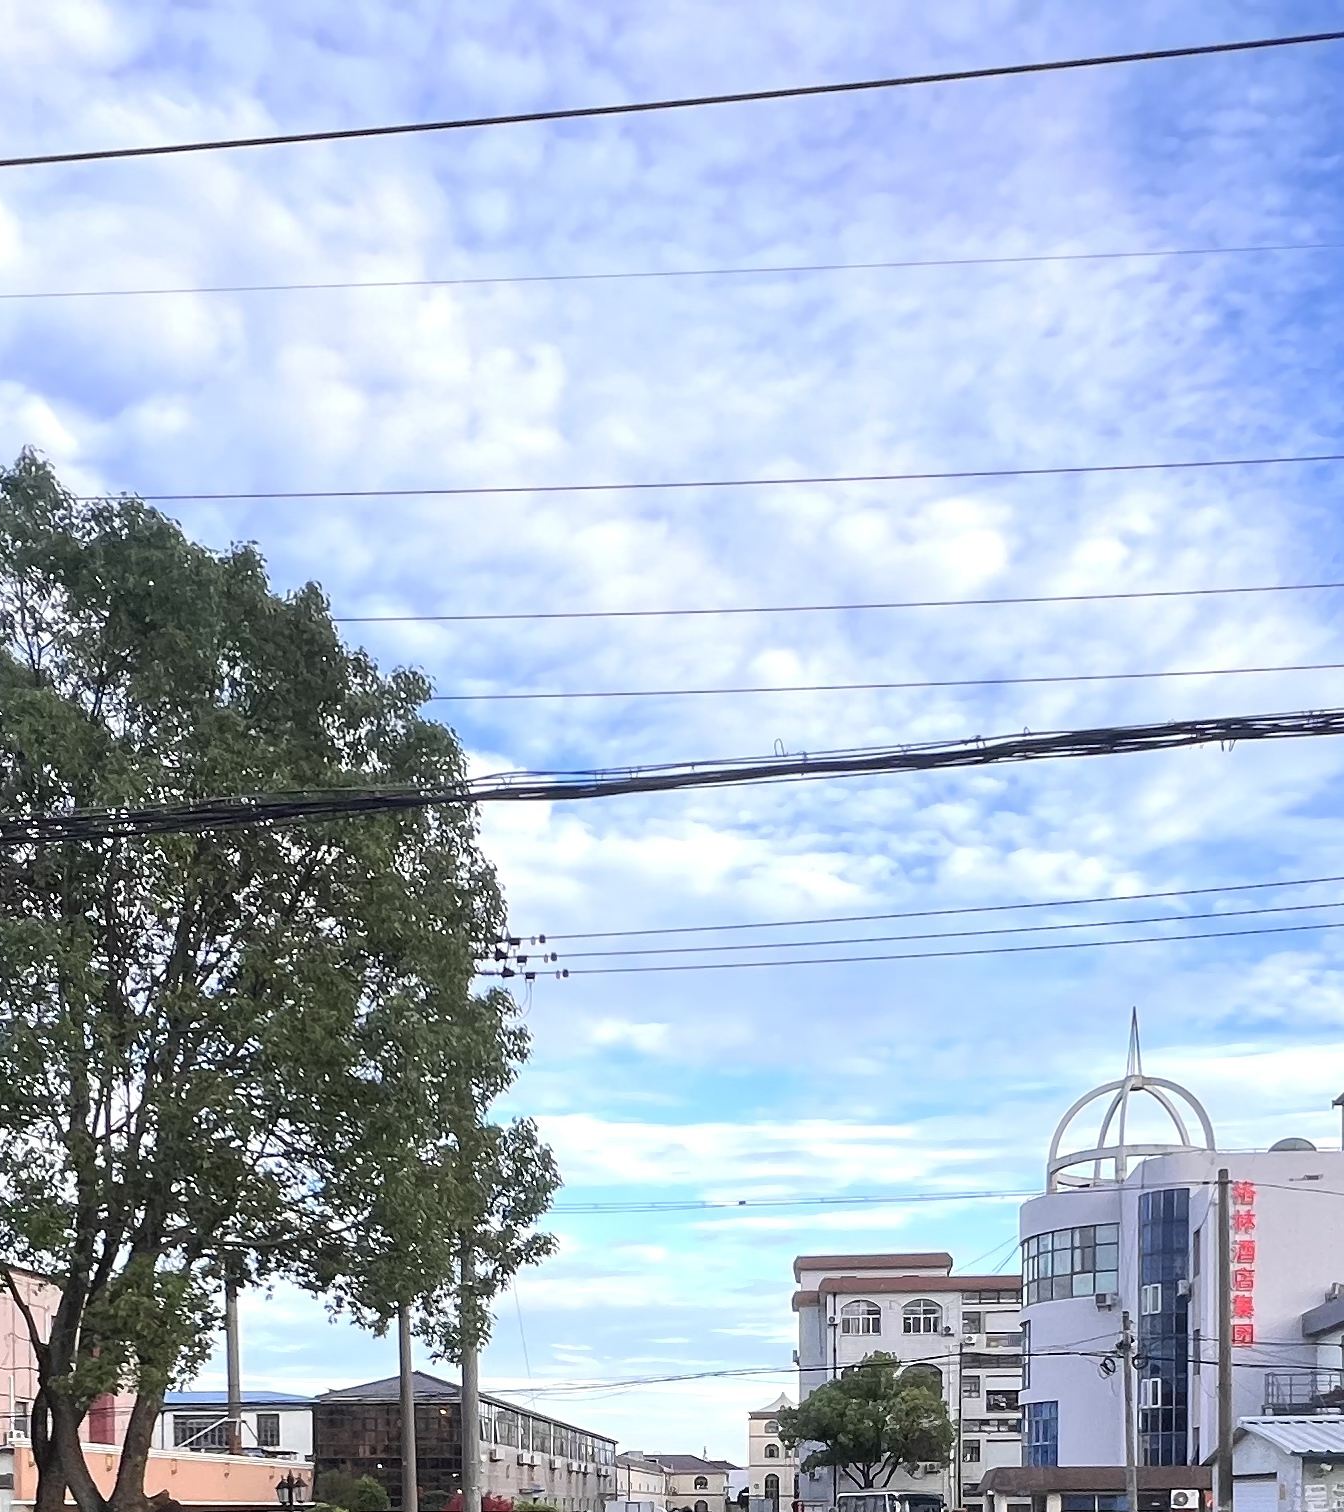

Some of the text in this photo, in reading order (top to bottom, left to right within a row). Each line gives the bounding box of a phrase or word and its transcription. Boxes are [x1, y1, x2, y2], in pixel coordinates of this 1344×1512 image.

[1231, 1180, 1257, 1348] 格林酒店集团
